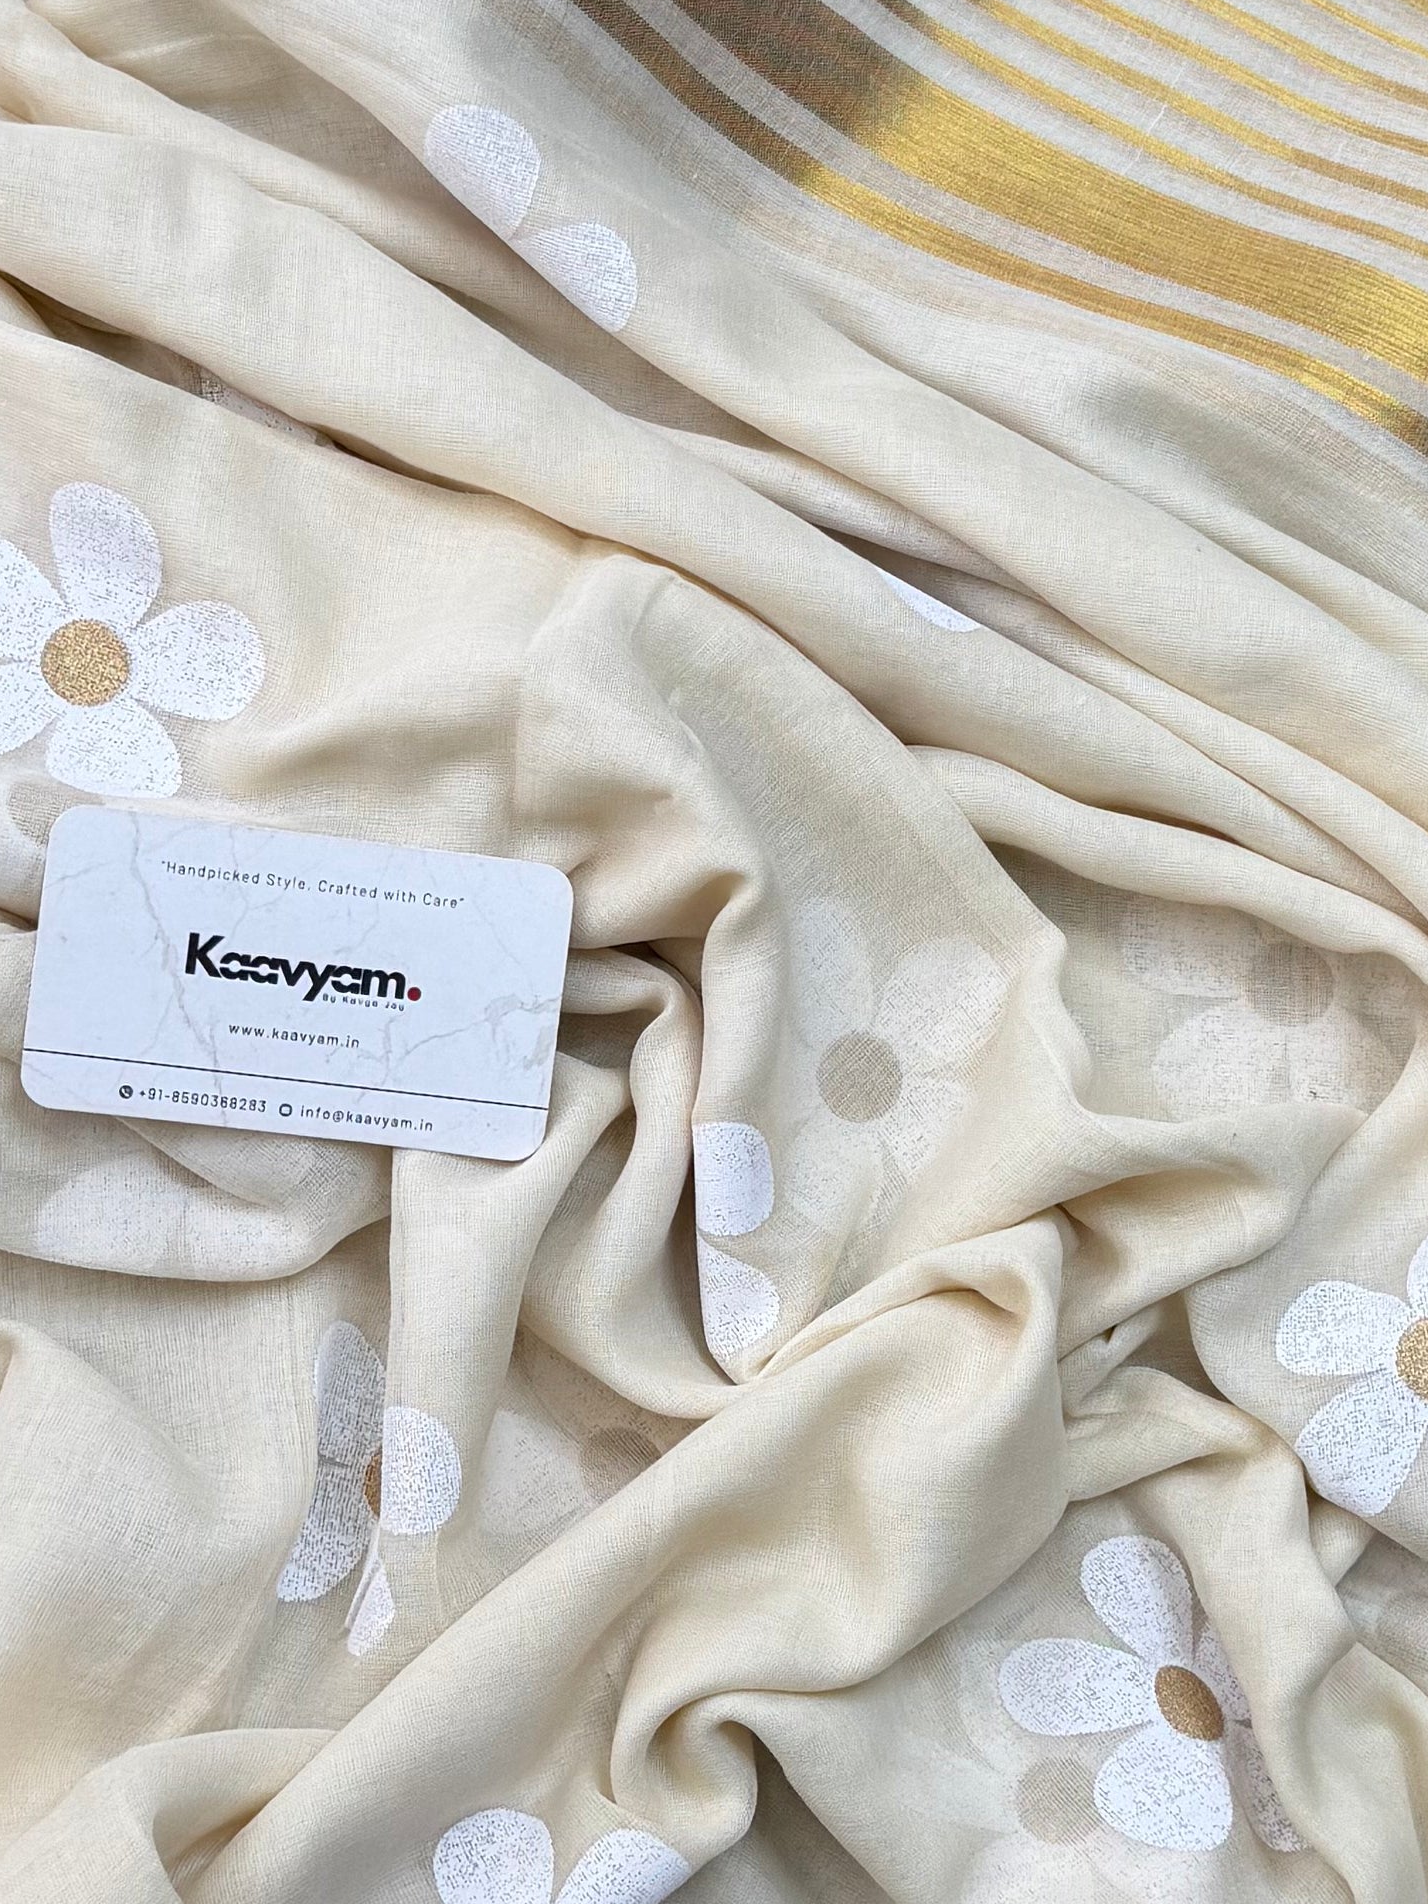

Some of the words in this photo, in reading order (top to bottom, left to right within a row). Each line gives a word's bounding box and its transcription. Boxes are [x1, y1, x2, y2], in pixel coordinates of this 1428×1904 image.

[161, 860, 260, 885] "Handpicked
[318, 879, 377, 899] Crafted
[383, 889, 416, 904] with
[423, 892, 465, 909] Care"
[228, 1022, 360, 1050] www.kaavyam.in
[139, 1087, 268, 1113] +91-8590368283
[300, 1104, 434, 1133] info@kaavyam.in
